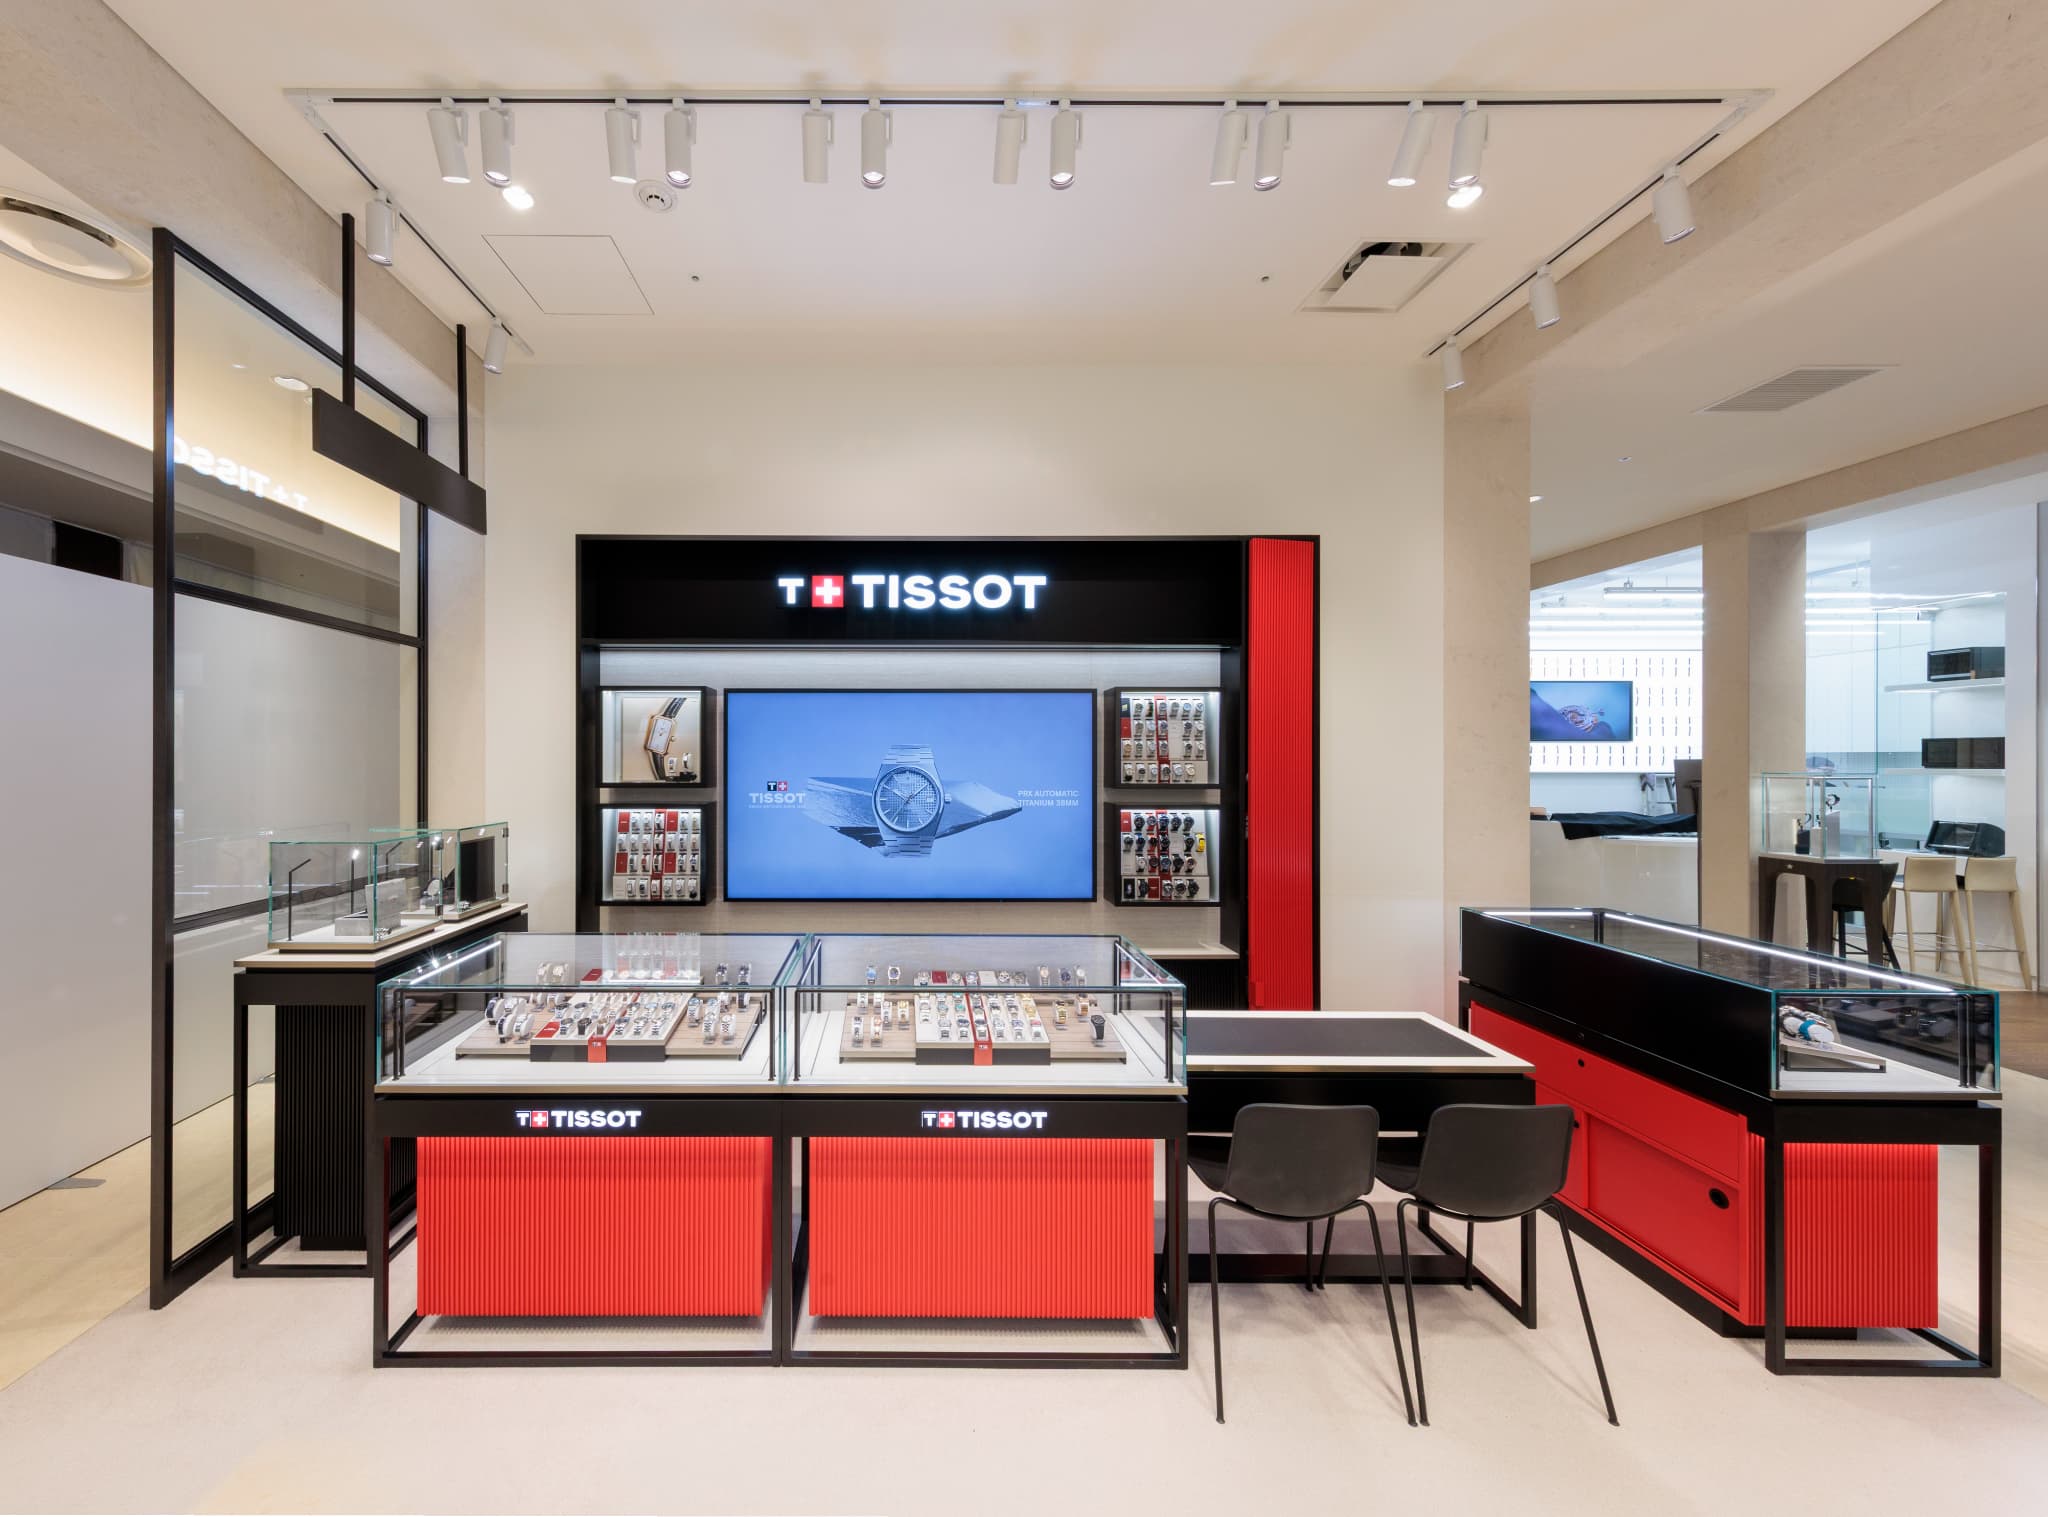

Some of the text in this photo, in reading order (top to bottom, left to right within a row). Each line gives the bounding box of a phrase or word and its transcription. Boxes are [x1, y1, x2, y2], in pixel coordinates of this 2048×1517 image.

[778, 575, 1047, 609] T TISSOT
[749, 792, 806, 804] TISSOT
[516, 1110, 642, 1128] T TISSOT
[923, 1111, 1048, 1129] T TISSOT
